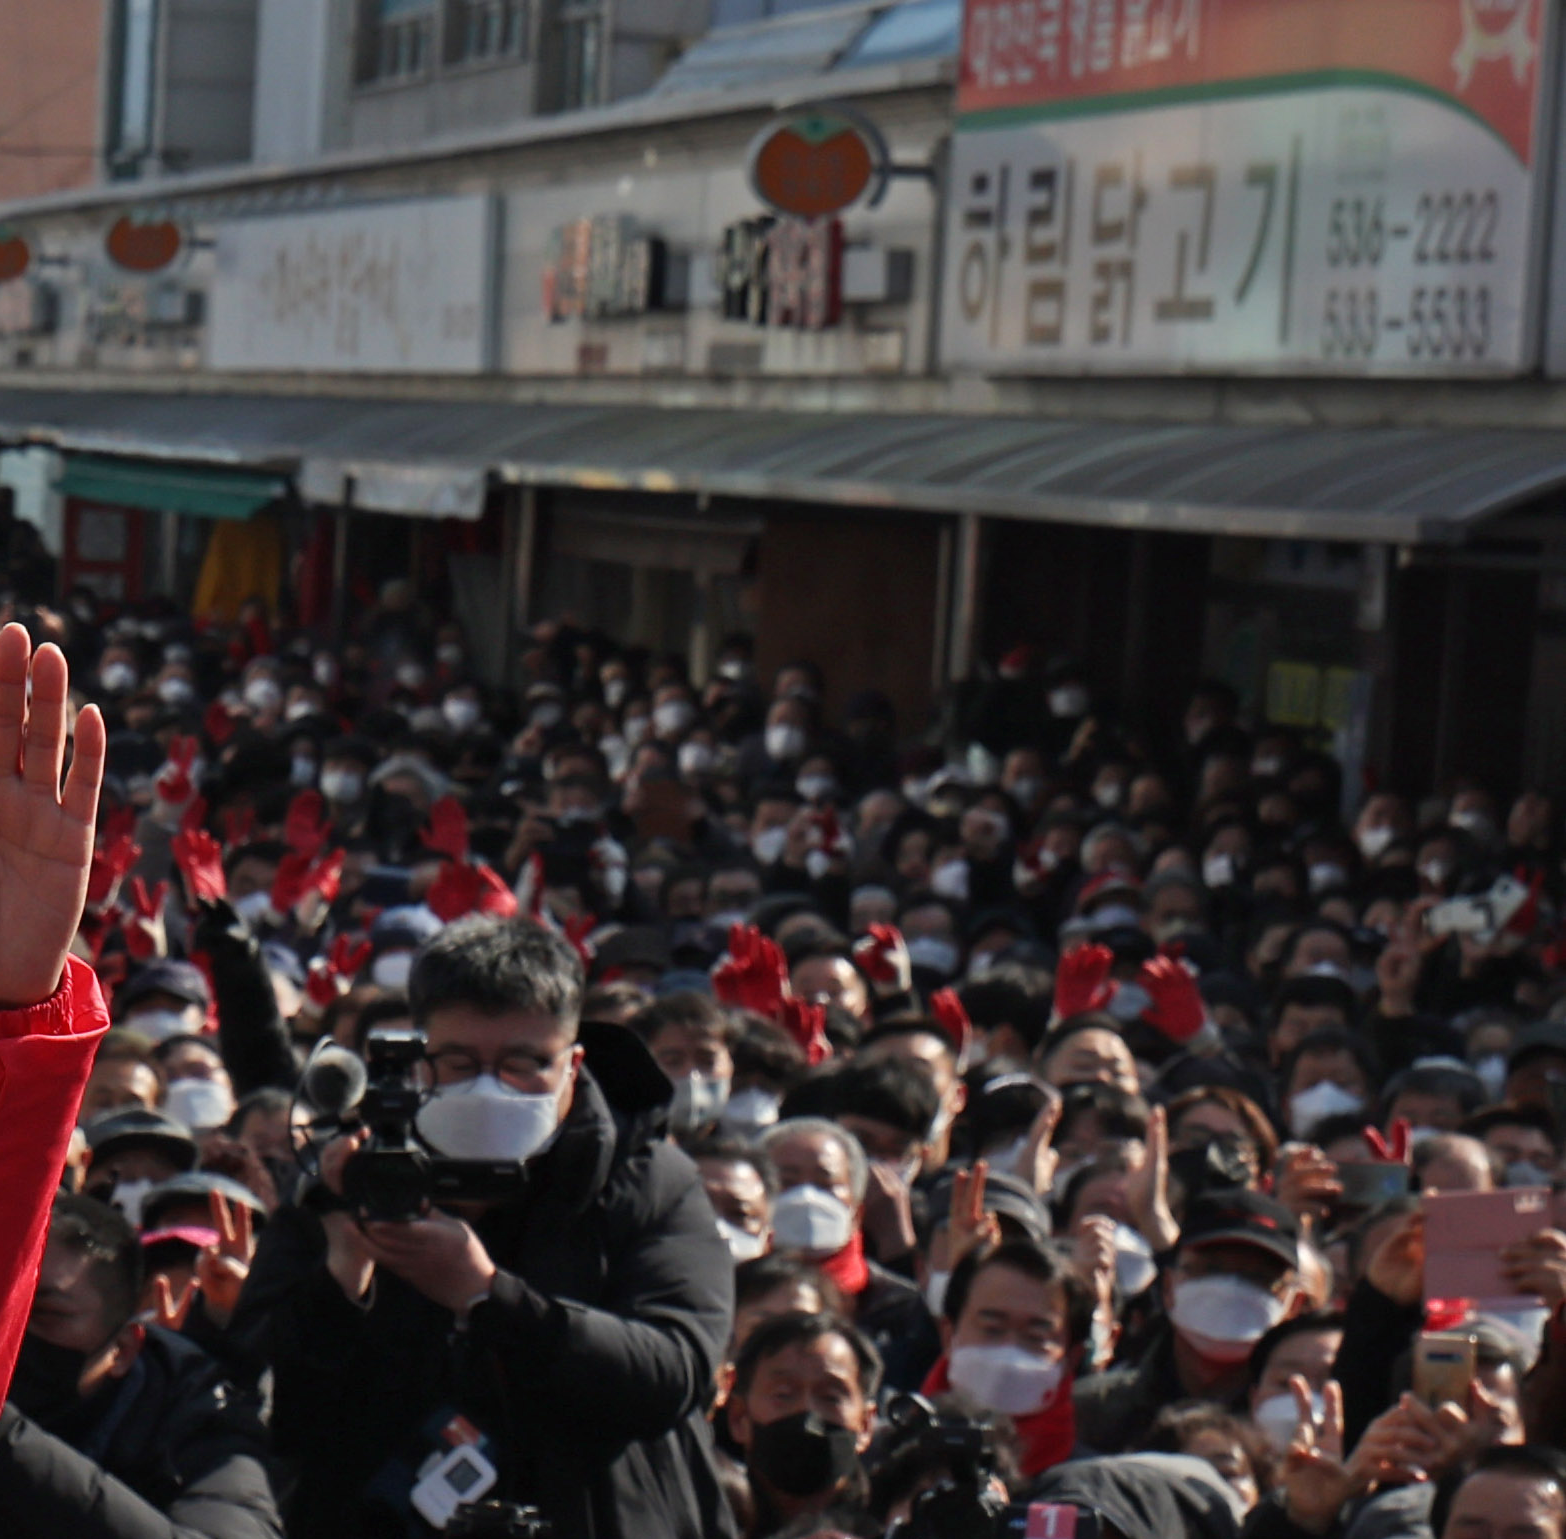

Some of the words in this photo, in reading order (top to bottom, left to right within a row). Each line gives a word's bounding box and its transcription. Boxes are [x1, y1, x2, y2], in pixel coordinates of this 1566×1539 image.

[1327, 188, 1499, 267] 536-2222
[1320, 285, 1492, 358] 533-5533
[1041, 1507, 1060, 1538] 1
